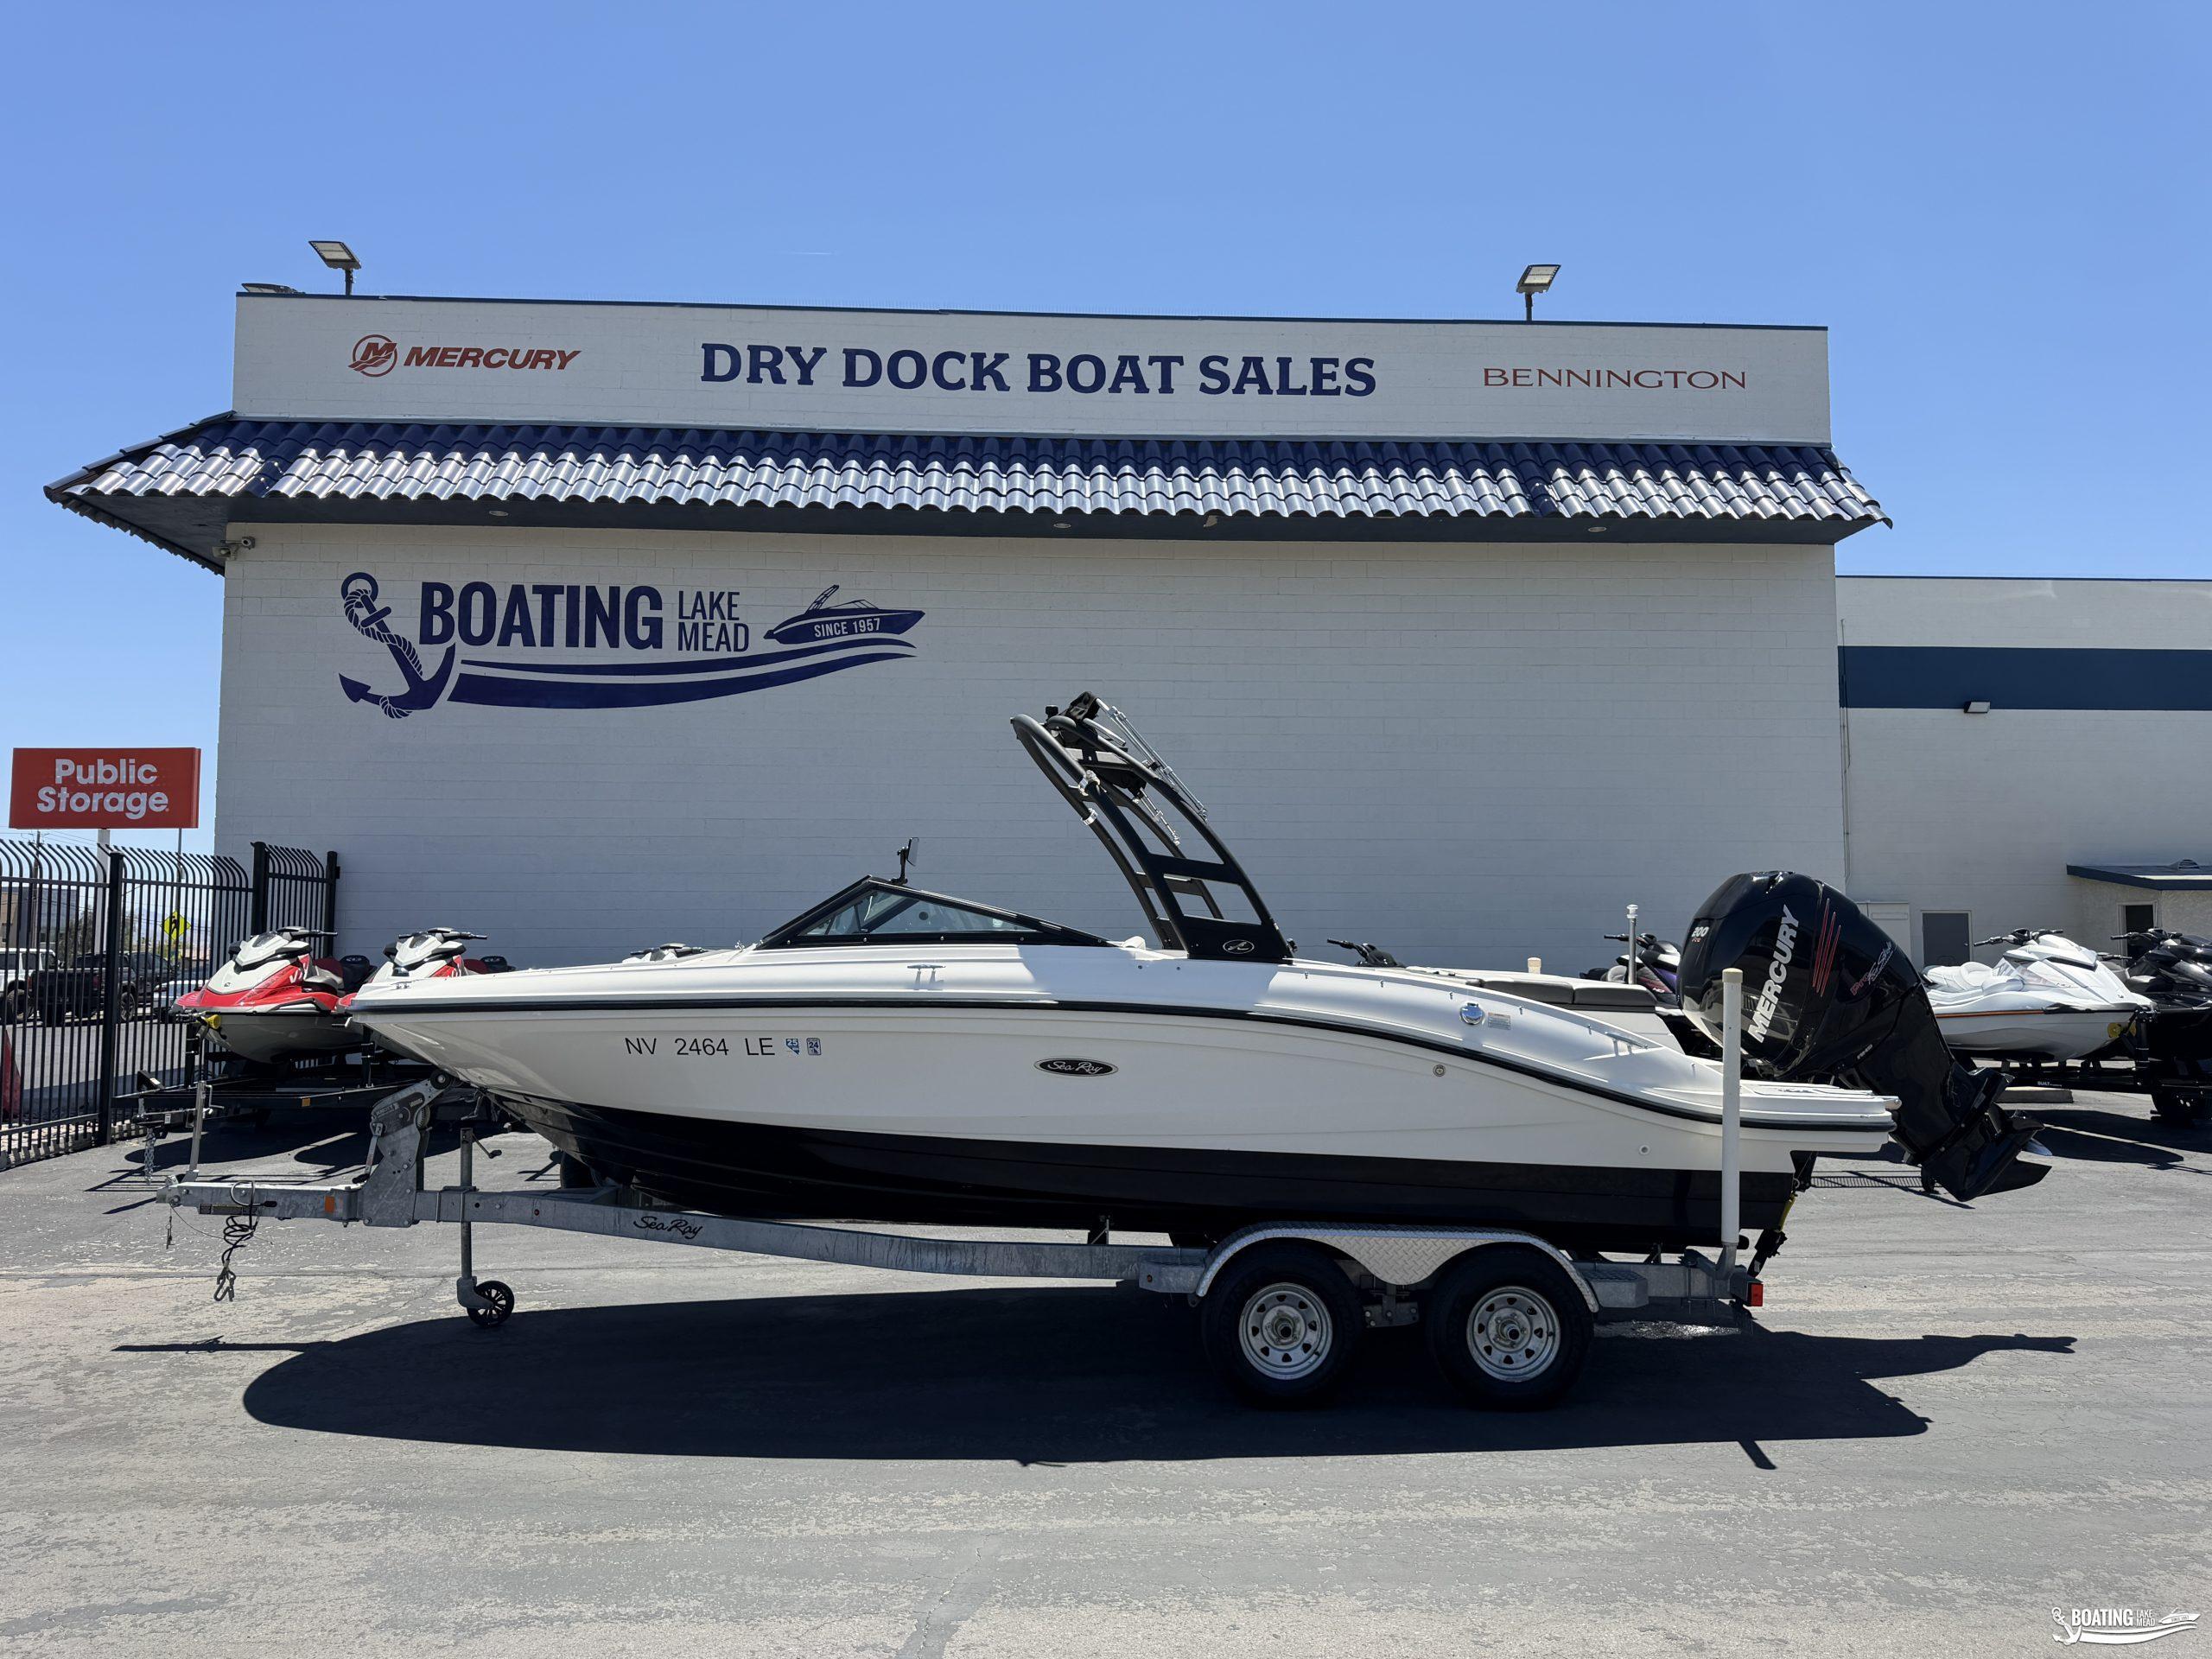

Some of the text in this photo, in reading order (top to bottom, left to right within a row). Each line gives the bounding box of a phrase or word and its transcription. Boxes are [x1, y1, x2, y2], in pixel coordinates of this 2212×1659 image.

[404, 346, 582, 370] MERCURY
[701, 343, 1376, 397] DRY DOCK BOAT SALES
[1484, 367, 1746, 390] BENNINGTON
[418, 582, 664, 650] BOATING
[678, 590, 741, 621] LAKE
[677, 622, 749, 652] MEAD
[814, 618, 881, 638] SINCE 1957
[54, 758, 158, 785] Public
[36, 785, 169, 820] Storage
[1691, 926, 1710, 938] 200
[1747, 904, 1799, 1043] MERCURY
[625, 1037, 775, 1056] NV 2464 LE
[1047, 1061, 1103, 1075] Sea Ray
[632, 1216, 703, 1240] Sea Ray
